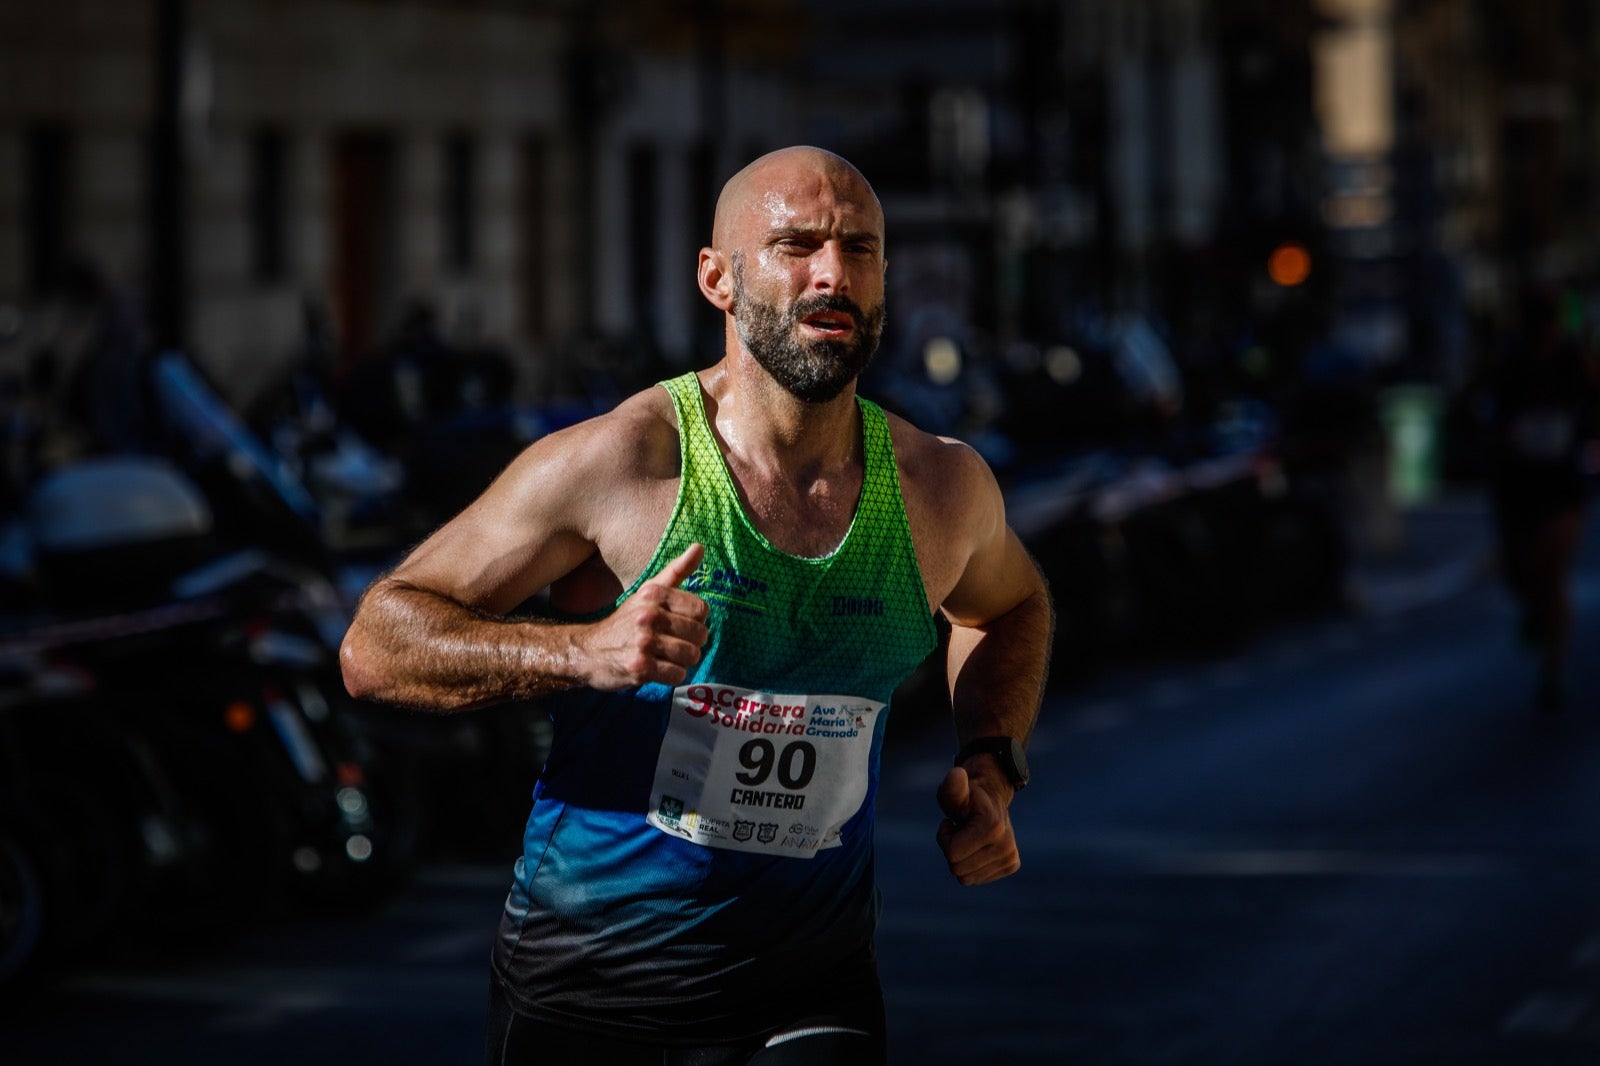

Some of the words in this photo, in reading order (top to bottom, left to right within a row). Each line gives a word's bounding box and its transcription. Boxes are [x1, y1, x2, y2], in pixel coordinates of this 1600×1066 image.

[685, 685, 714, 718] 9
[717, 688, 805, 719] Carrera
[812, 704, 835, 716] Ave
[710, 706, 806, 736] Solidaria
[809, 716, 845, 727] María
[806, 727, 858, 738] Granada
[735, 738, 817, 791] 90
[730, 788, 806, 810] CANTERO
[699, 824, 719, 834] REAL
